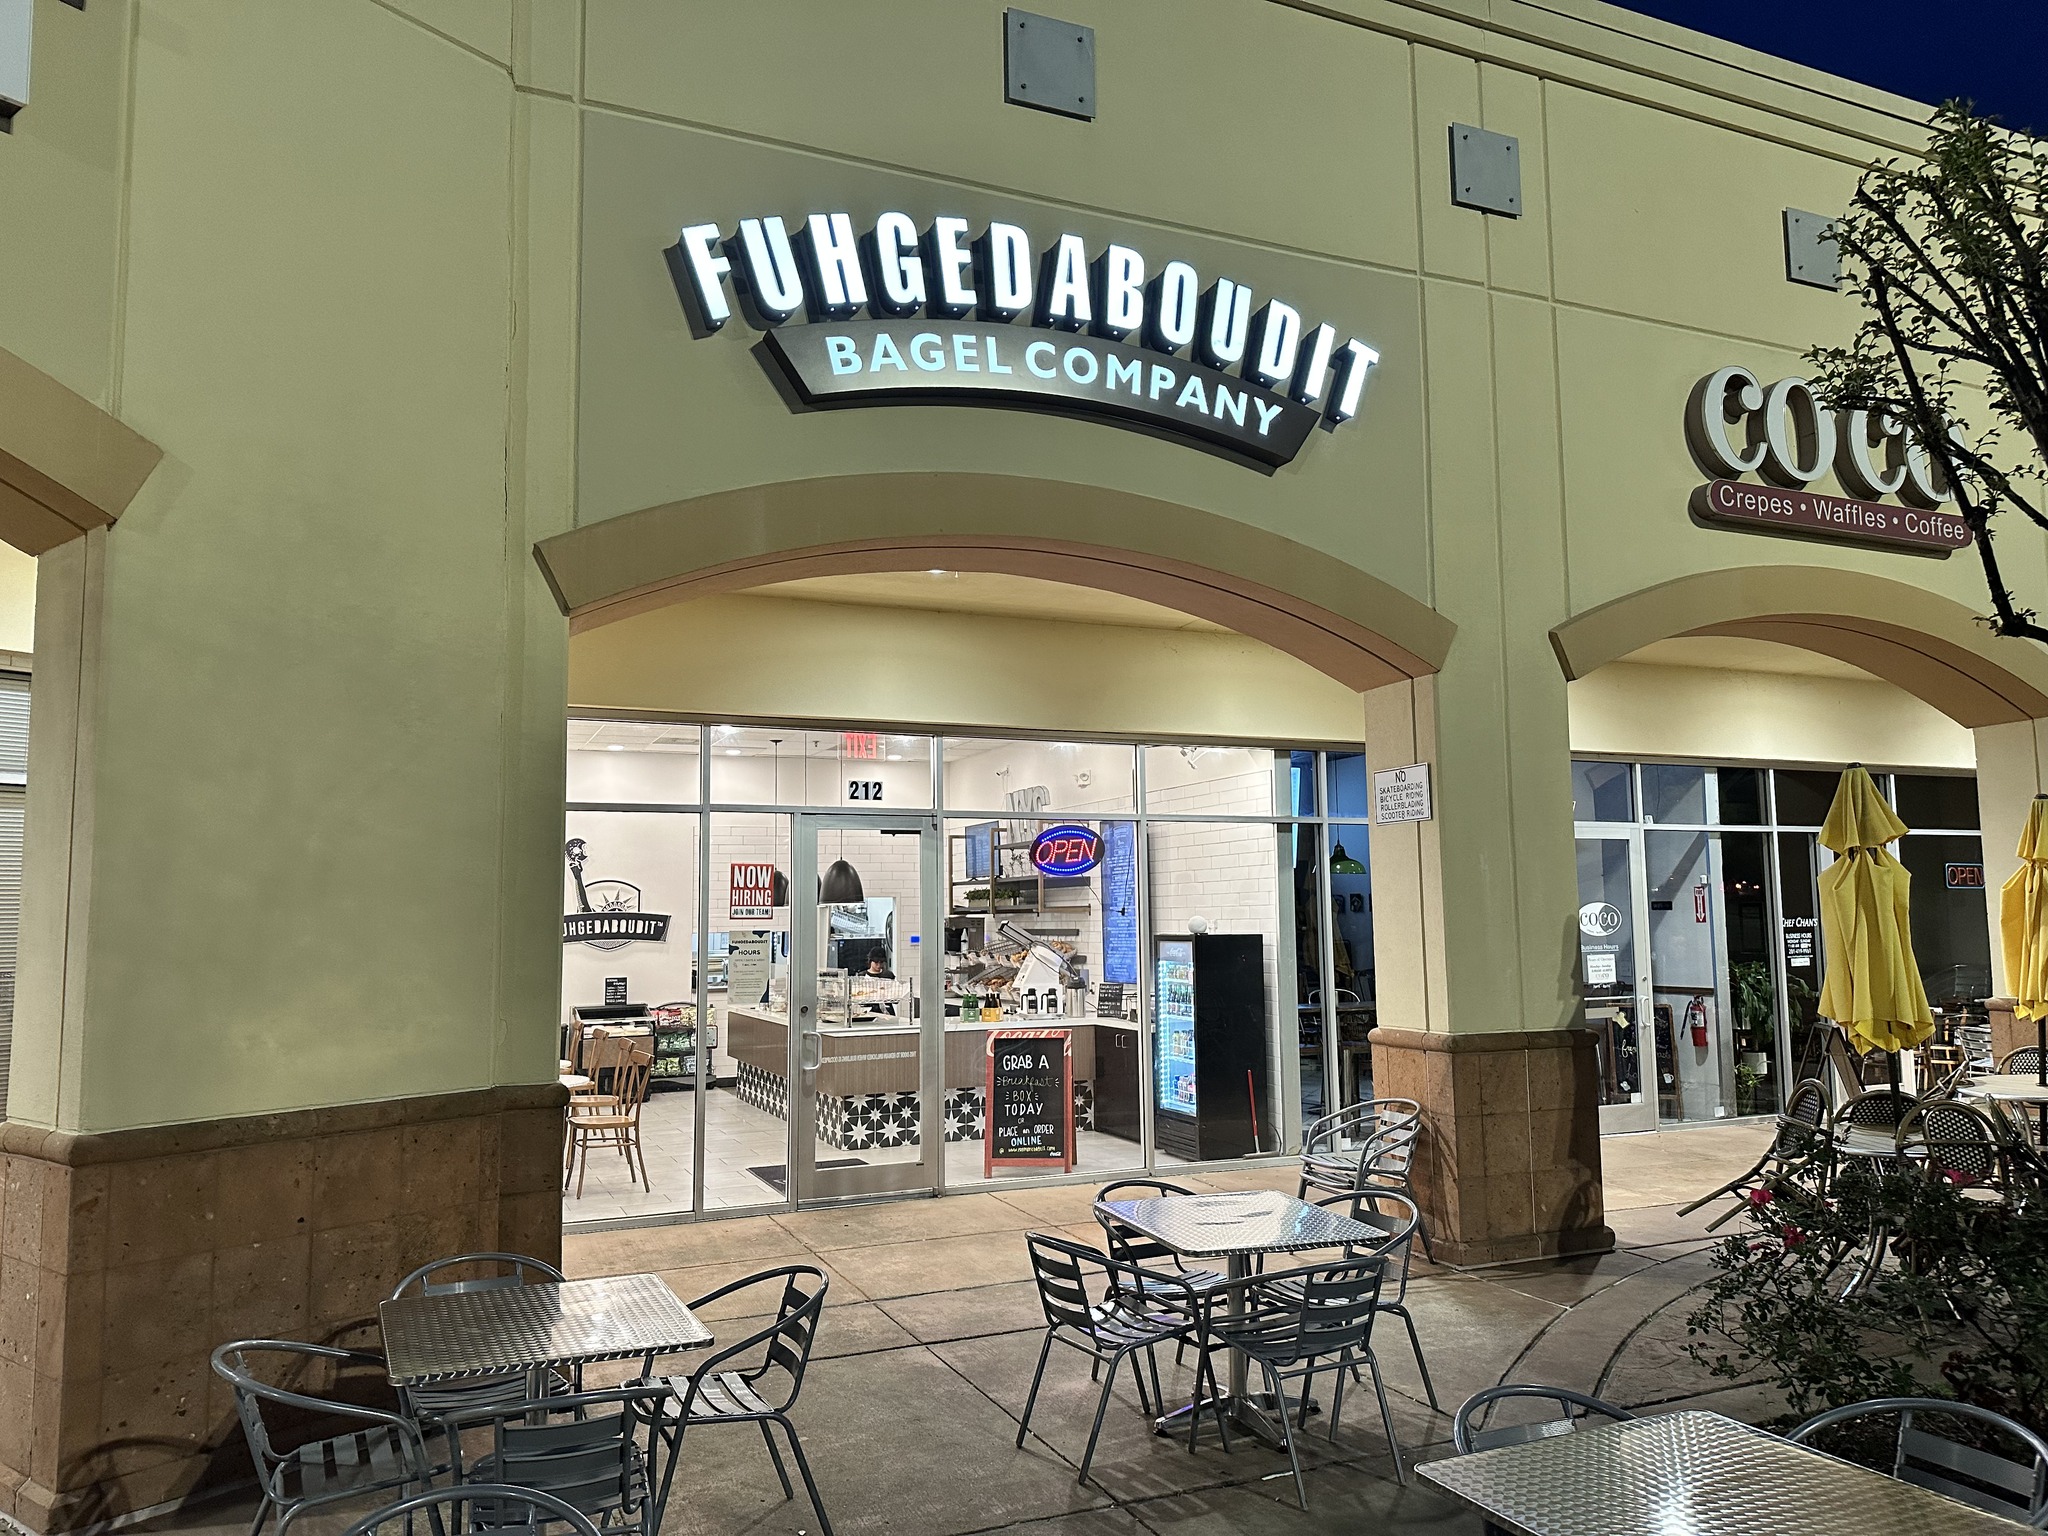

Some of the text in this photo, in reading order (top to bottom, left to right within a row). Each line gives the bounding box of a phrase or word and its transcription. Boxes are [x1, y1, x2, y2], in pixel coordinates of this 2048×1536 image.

[680, 211, 1380, 418] FUHGEDABOUDIT
[825, 332, 1284, 437] BAGEL COMPANY
[1719, 485, 1965, 541] Crepes Waffles Coffee
[1395, 770, 1407, 783] NO
[849, 780, 883, 801] 212
[1379, 781, 1423, 795] SKATEBOARDING
[1380, 790, 1424, 804] BICYCLE RIDING
[1380, 798, 1424, 812] ROLLERBLADING
[1381, 807, 1425, 820] SCOOTER RIDING
[1036, 837, 1098, 865] OPEN
[733, 865, 772, 888] NOW
[1947, 866, 1983, 885] OPEN
[732, 889, 772, 906] HIRING
[732, 908, 744, 916] JOIN
[745, 908, 755, 916] OUR
[1580, 911, 1618, 927] COCO
[1002, 1054, 1050, 1071] GRAB A
[1012, 1089, 1032, 1102] BOX
[1004, 1102, 1044, 1117] TODAY
[998, 1125, 1019, 1138] PLACE
[1033, 1123, 1055, 1135] ORDER
[1010, 1135, 1043, 1147] ONLINE
